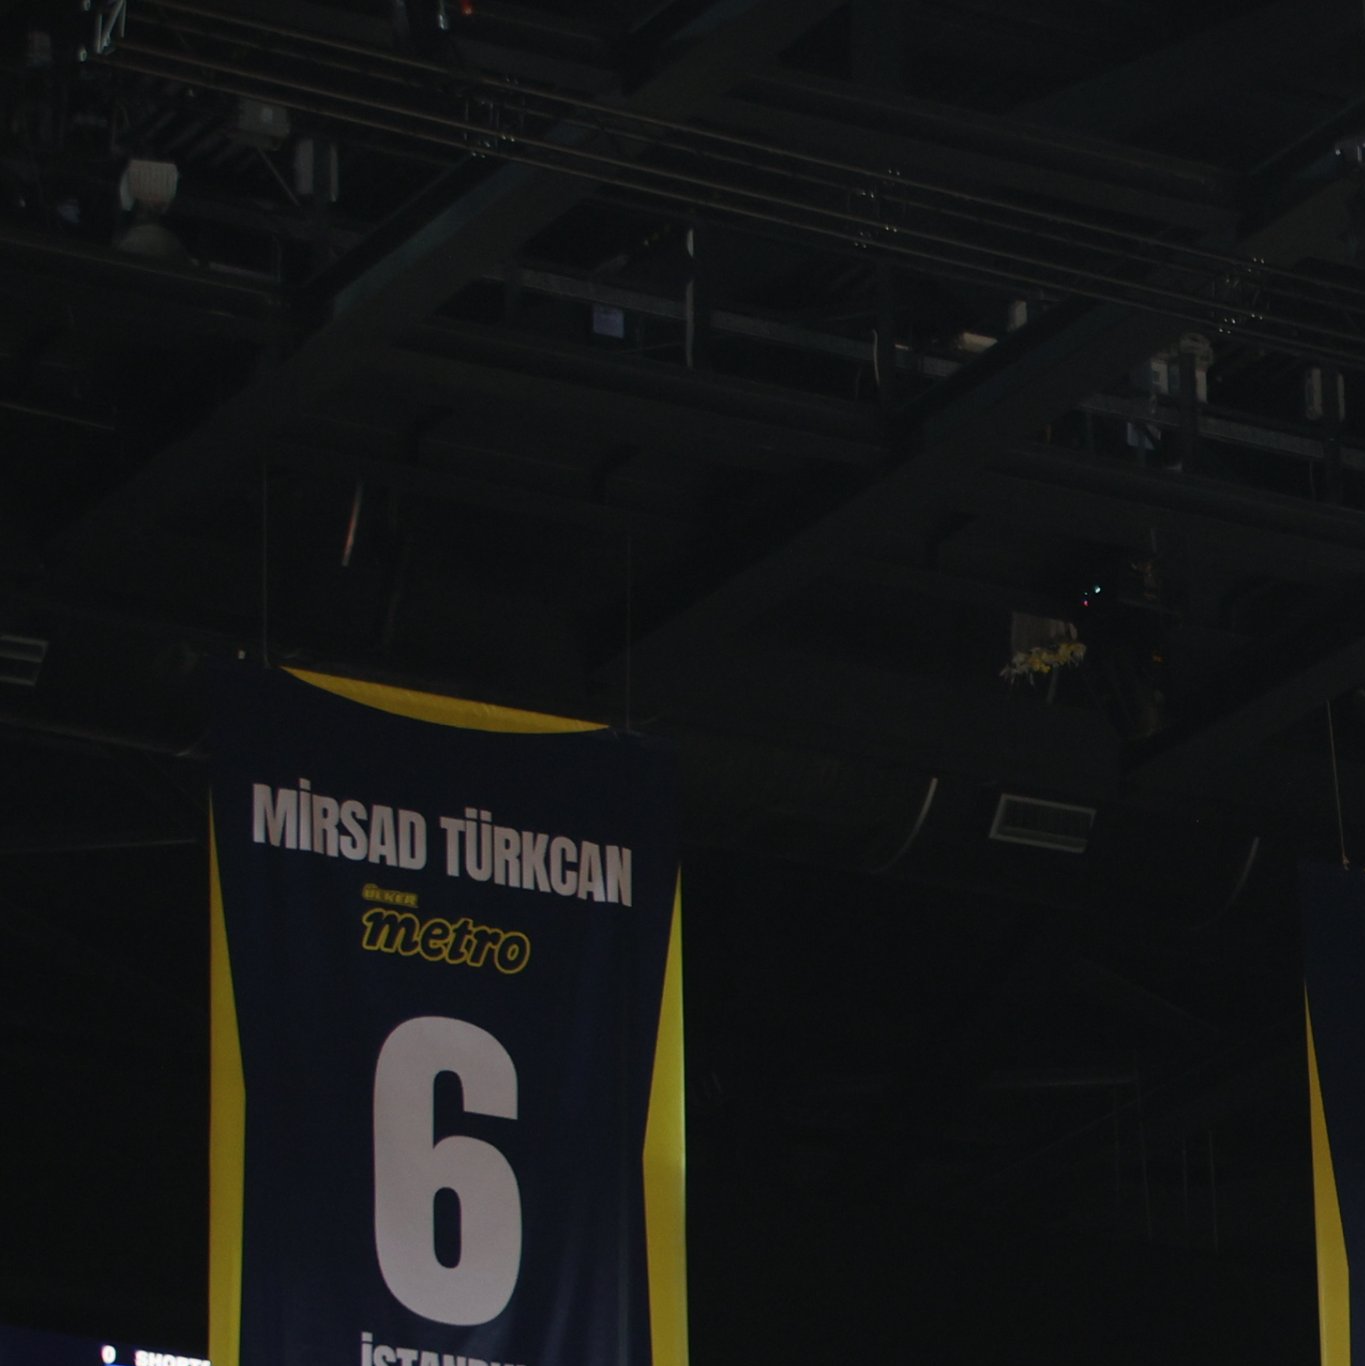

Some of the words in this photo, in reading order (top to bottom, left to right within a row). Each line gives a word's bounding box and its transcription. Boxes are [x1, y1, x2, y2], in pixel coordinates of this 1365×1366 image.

[252, 778, 426, 871] MİRSAD
[440, 808, 632, 907] TÜRKCAN
[361, 907, 531, 975] metro
[372, 1016, 523, 1327] 6
[102, 1345, 116, 1364] 0
